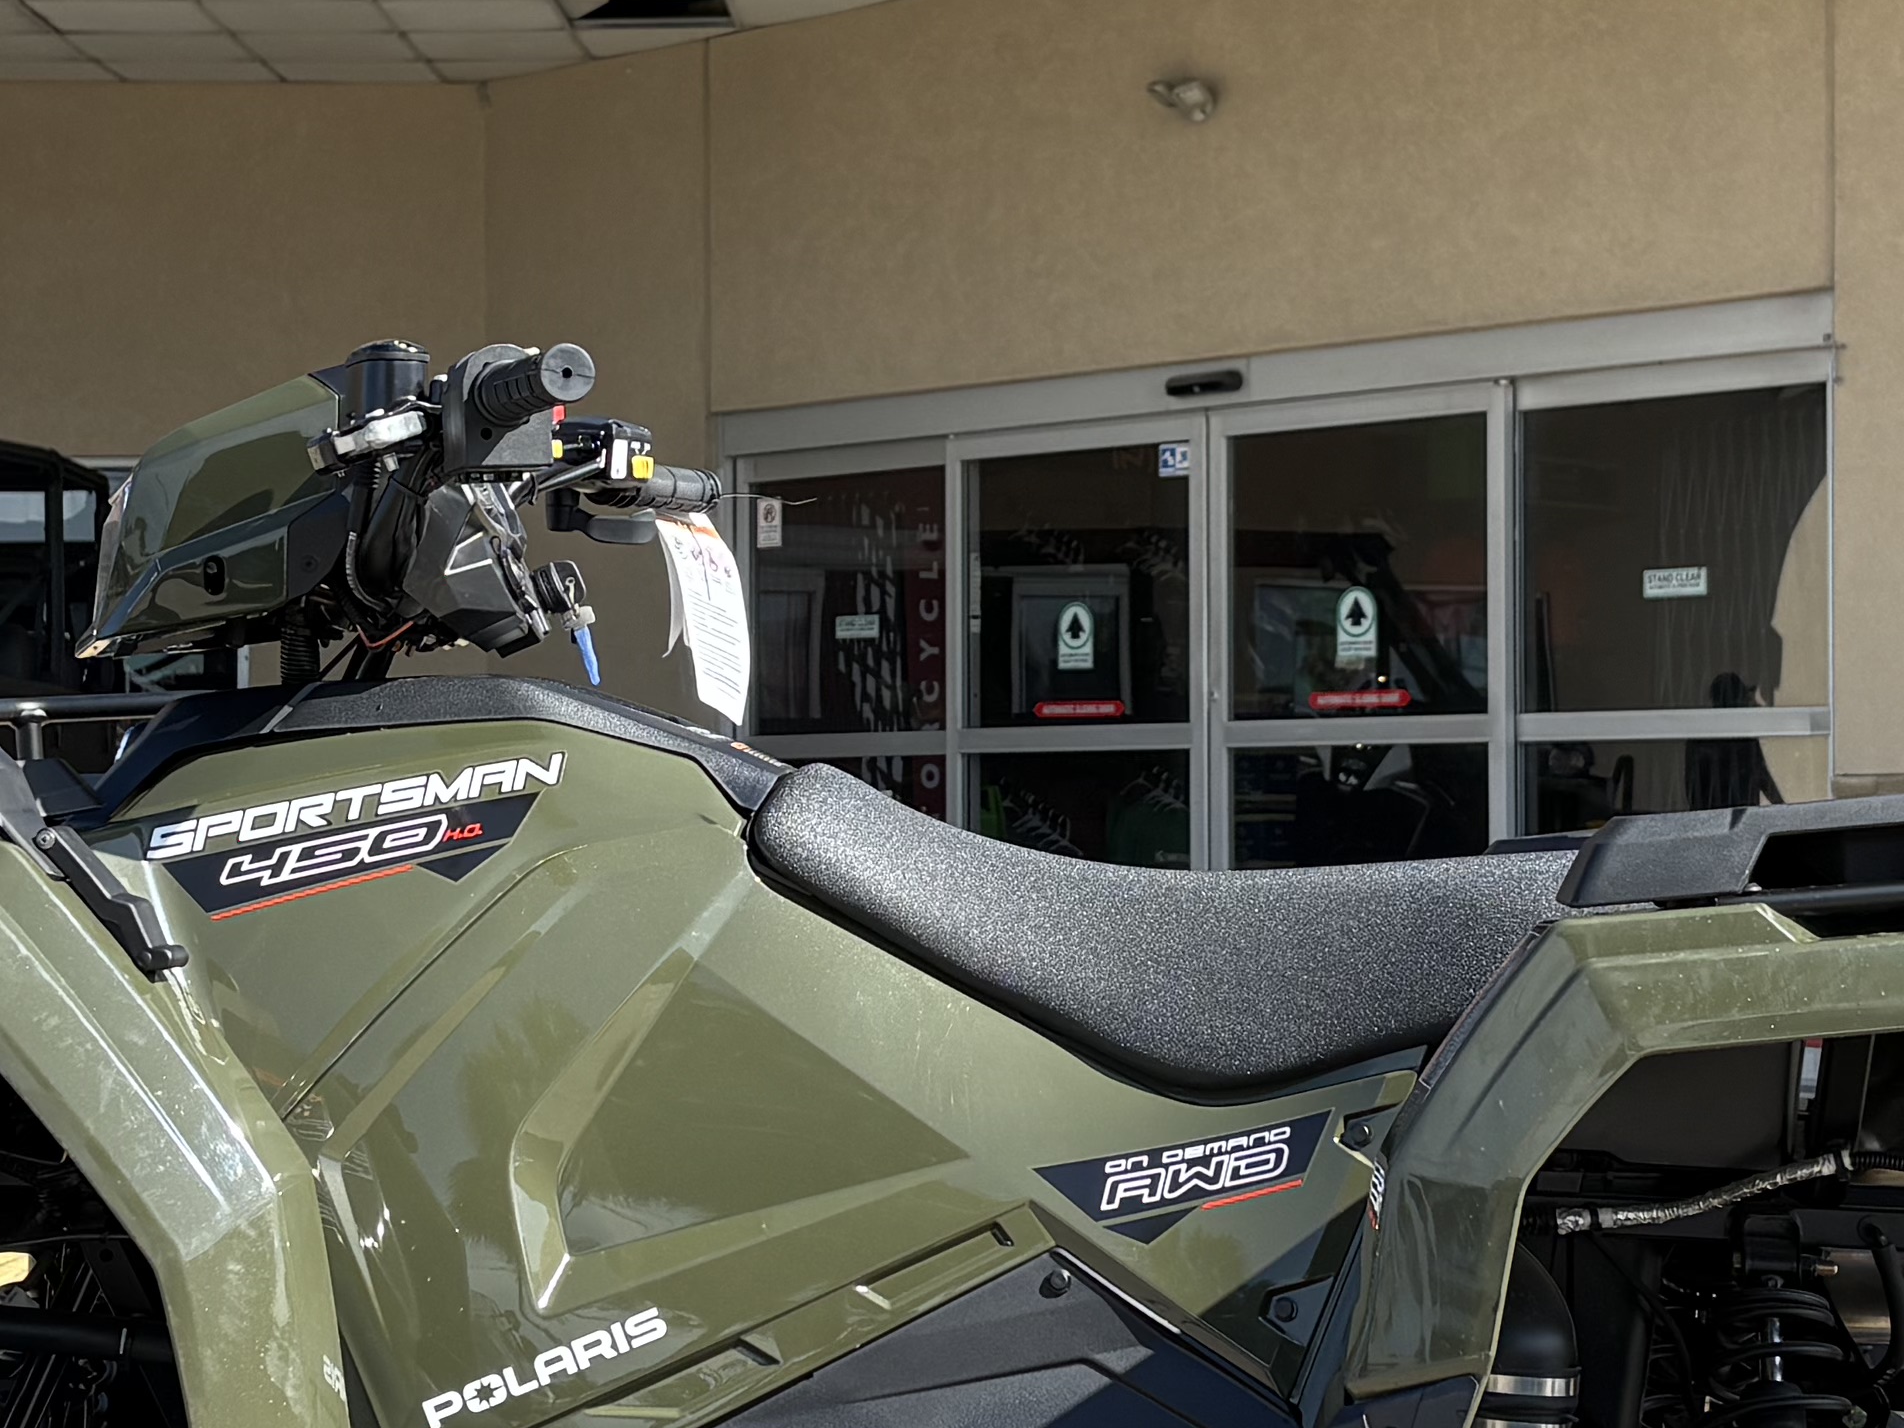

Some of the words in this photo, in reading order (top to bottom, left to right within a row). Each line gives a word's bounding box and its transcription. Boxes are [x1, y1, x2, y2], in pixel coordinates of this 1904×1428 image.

[146, 750, 567, 859] SPORTSMAN
[219, 813, 448, 887] 450
[1100, 1143, 1290, 1211] AWD
[1105, 1155, 1148, 1174] ON
[1162, 1126, 1291, 1164] DEMAND
